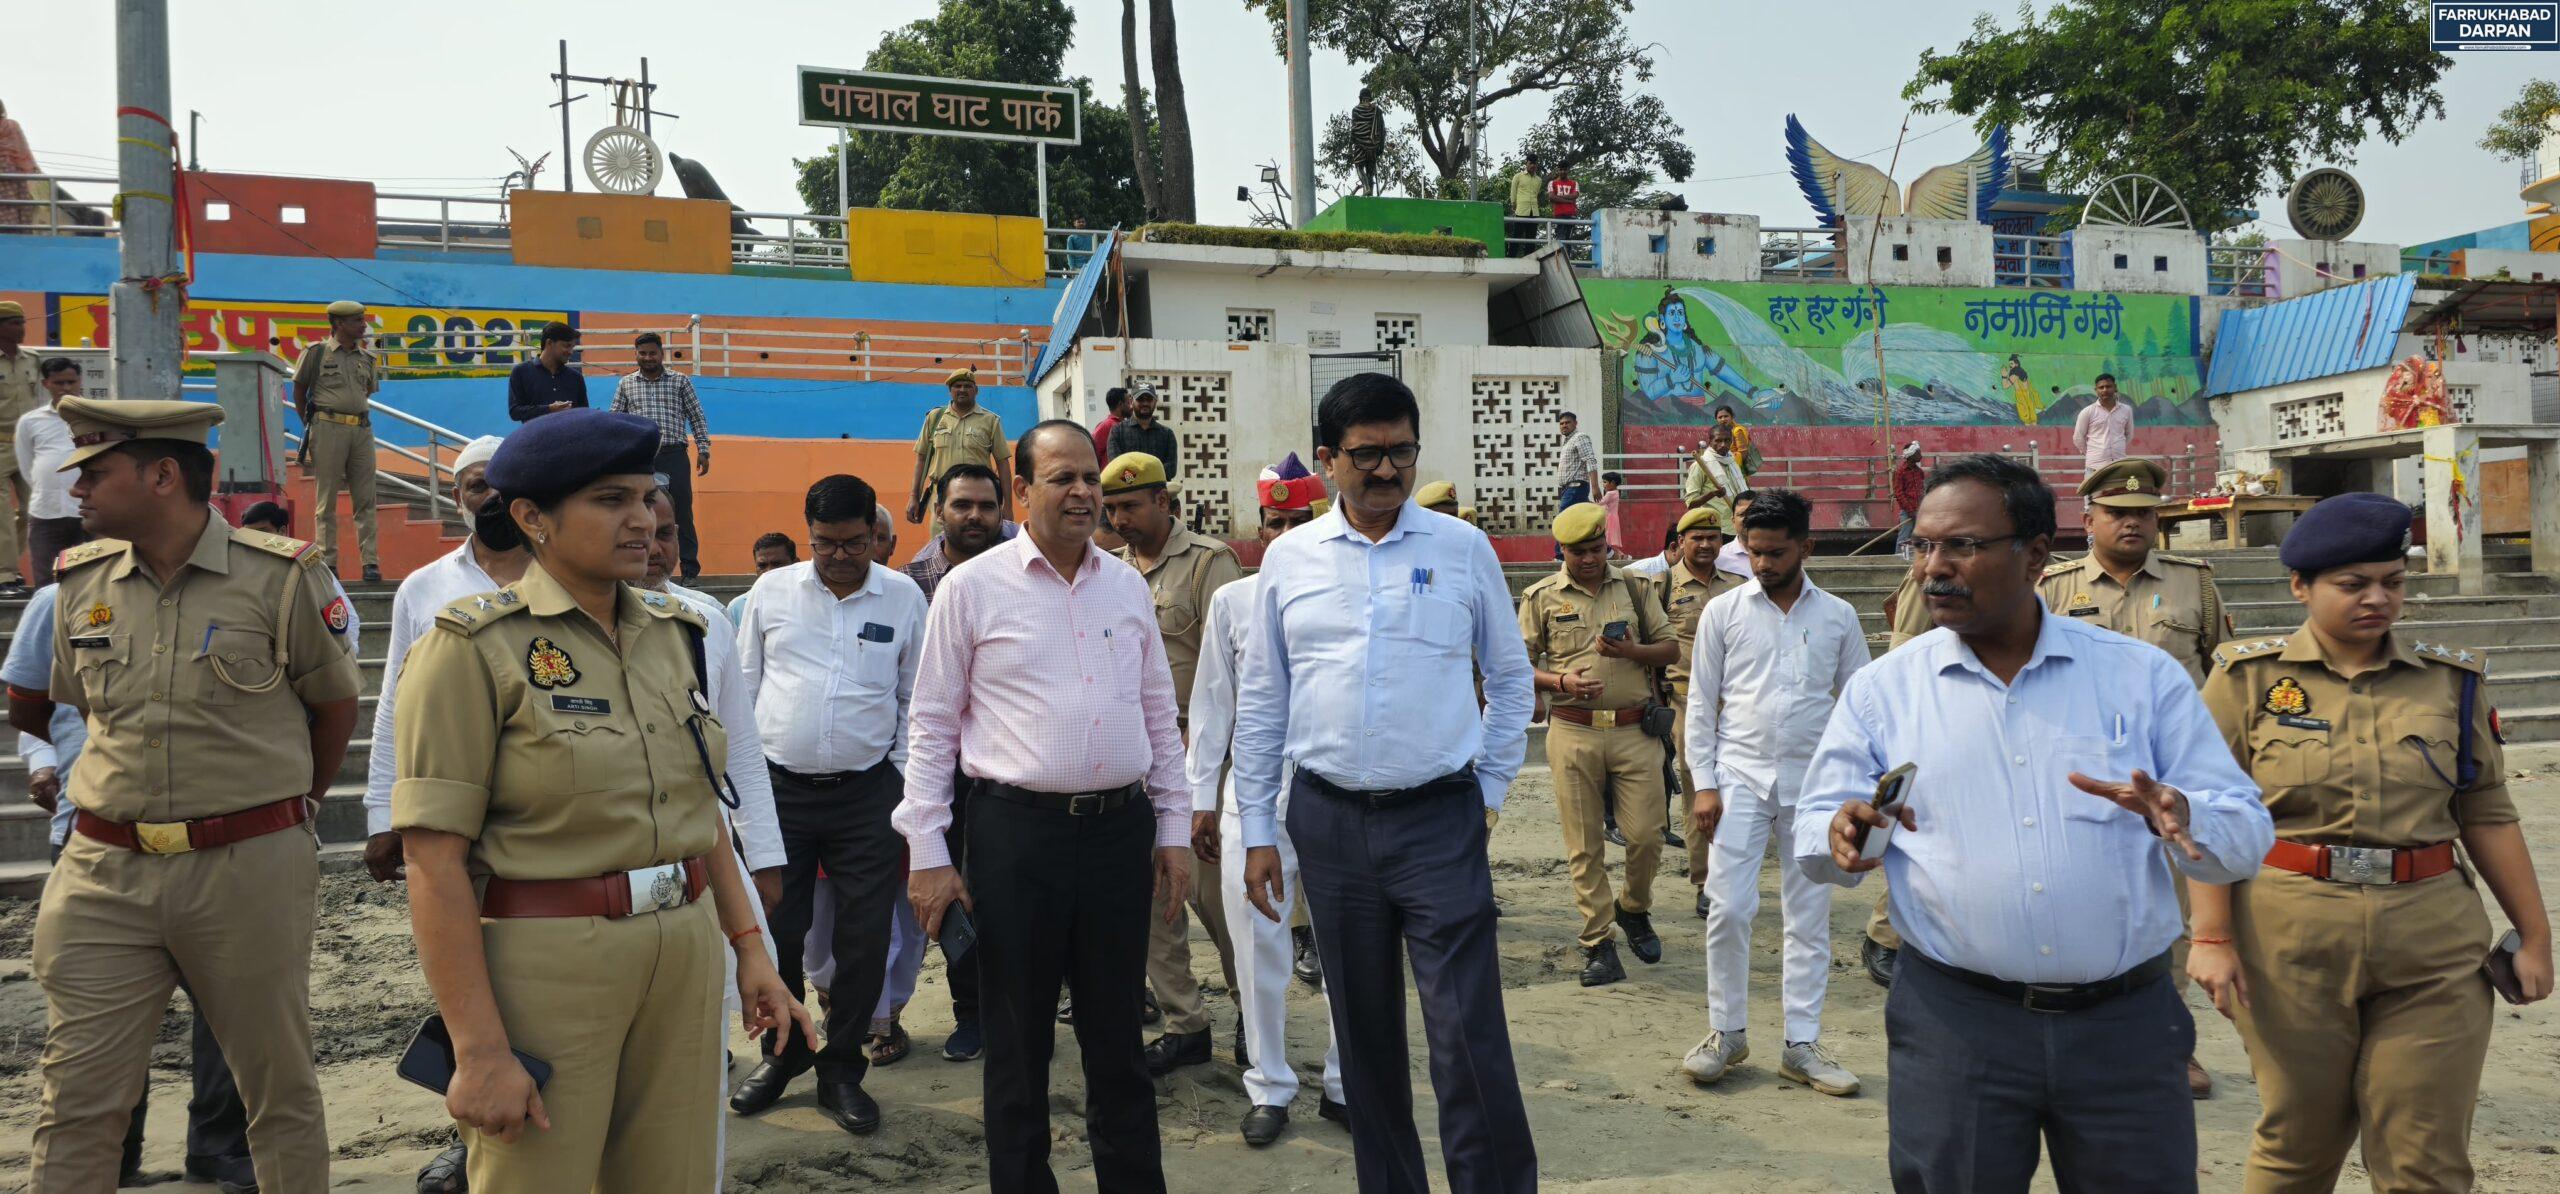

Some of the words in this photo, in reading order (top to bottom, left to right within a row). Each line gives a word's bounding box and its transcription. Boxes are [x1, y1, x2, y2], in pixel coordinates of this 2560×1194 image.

[931, 93, 990, 127] घाट
[1001, 91, 1062, 132] पार्क
[1768, 296, 1800, 334] हर
[1805, 295, 1839, 335] हर
[1965, 292, 2072, 340] नमामि
[2074, 293, 2123, 340] गंगे
